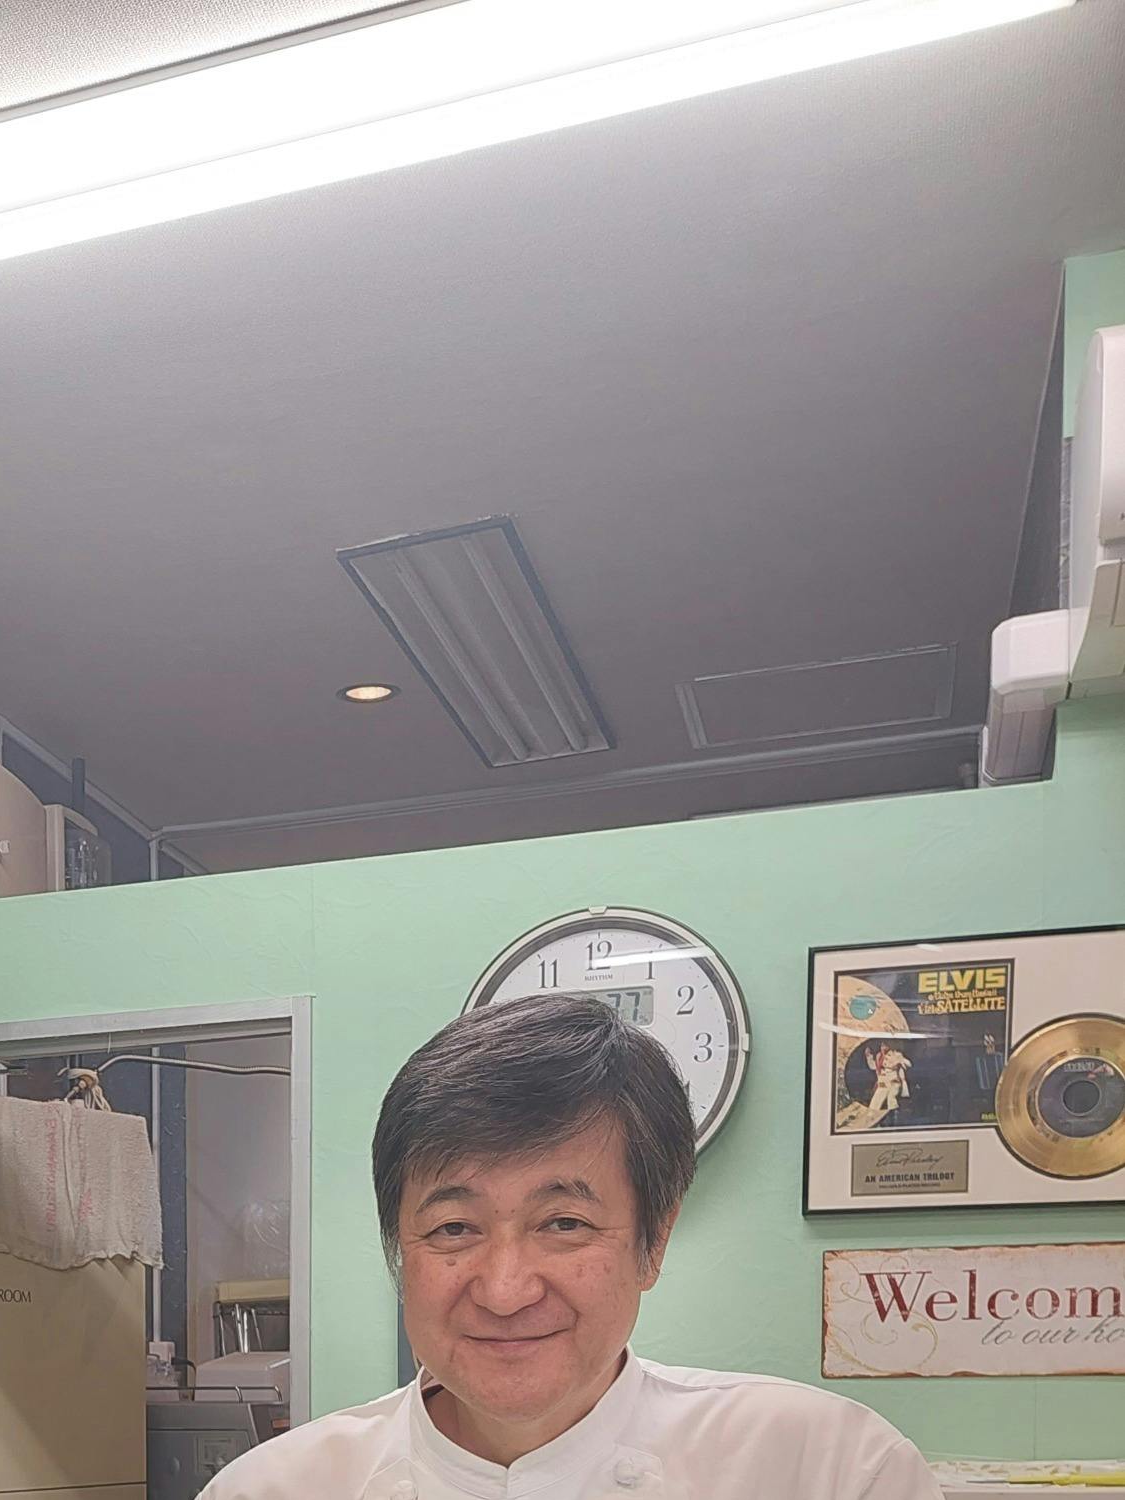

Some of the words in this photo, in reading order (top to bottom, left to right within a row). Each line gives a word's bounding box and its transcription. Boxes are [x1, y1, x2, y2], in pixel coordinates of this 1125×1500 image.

[584, 940, 613, 971] 12
[538, 959, 559, 989] 11
[918, 967, 1007, 993] ELVIS
[676, 986, 695, 1016] 2
[694, 1032, 713, 1063] 3
[879, 1173, 920, 1182] AMERICAN
[859, 1269, 1125, 1323] Welcom
